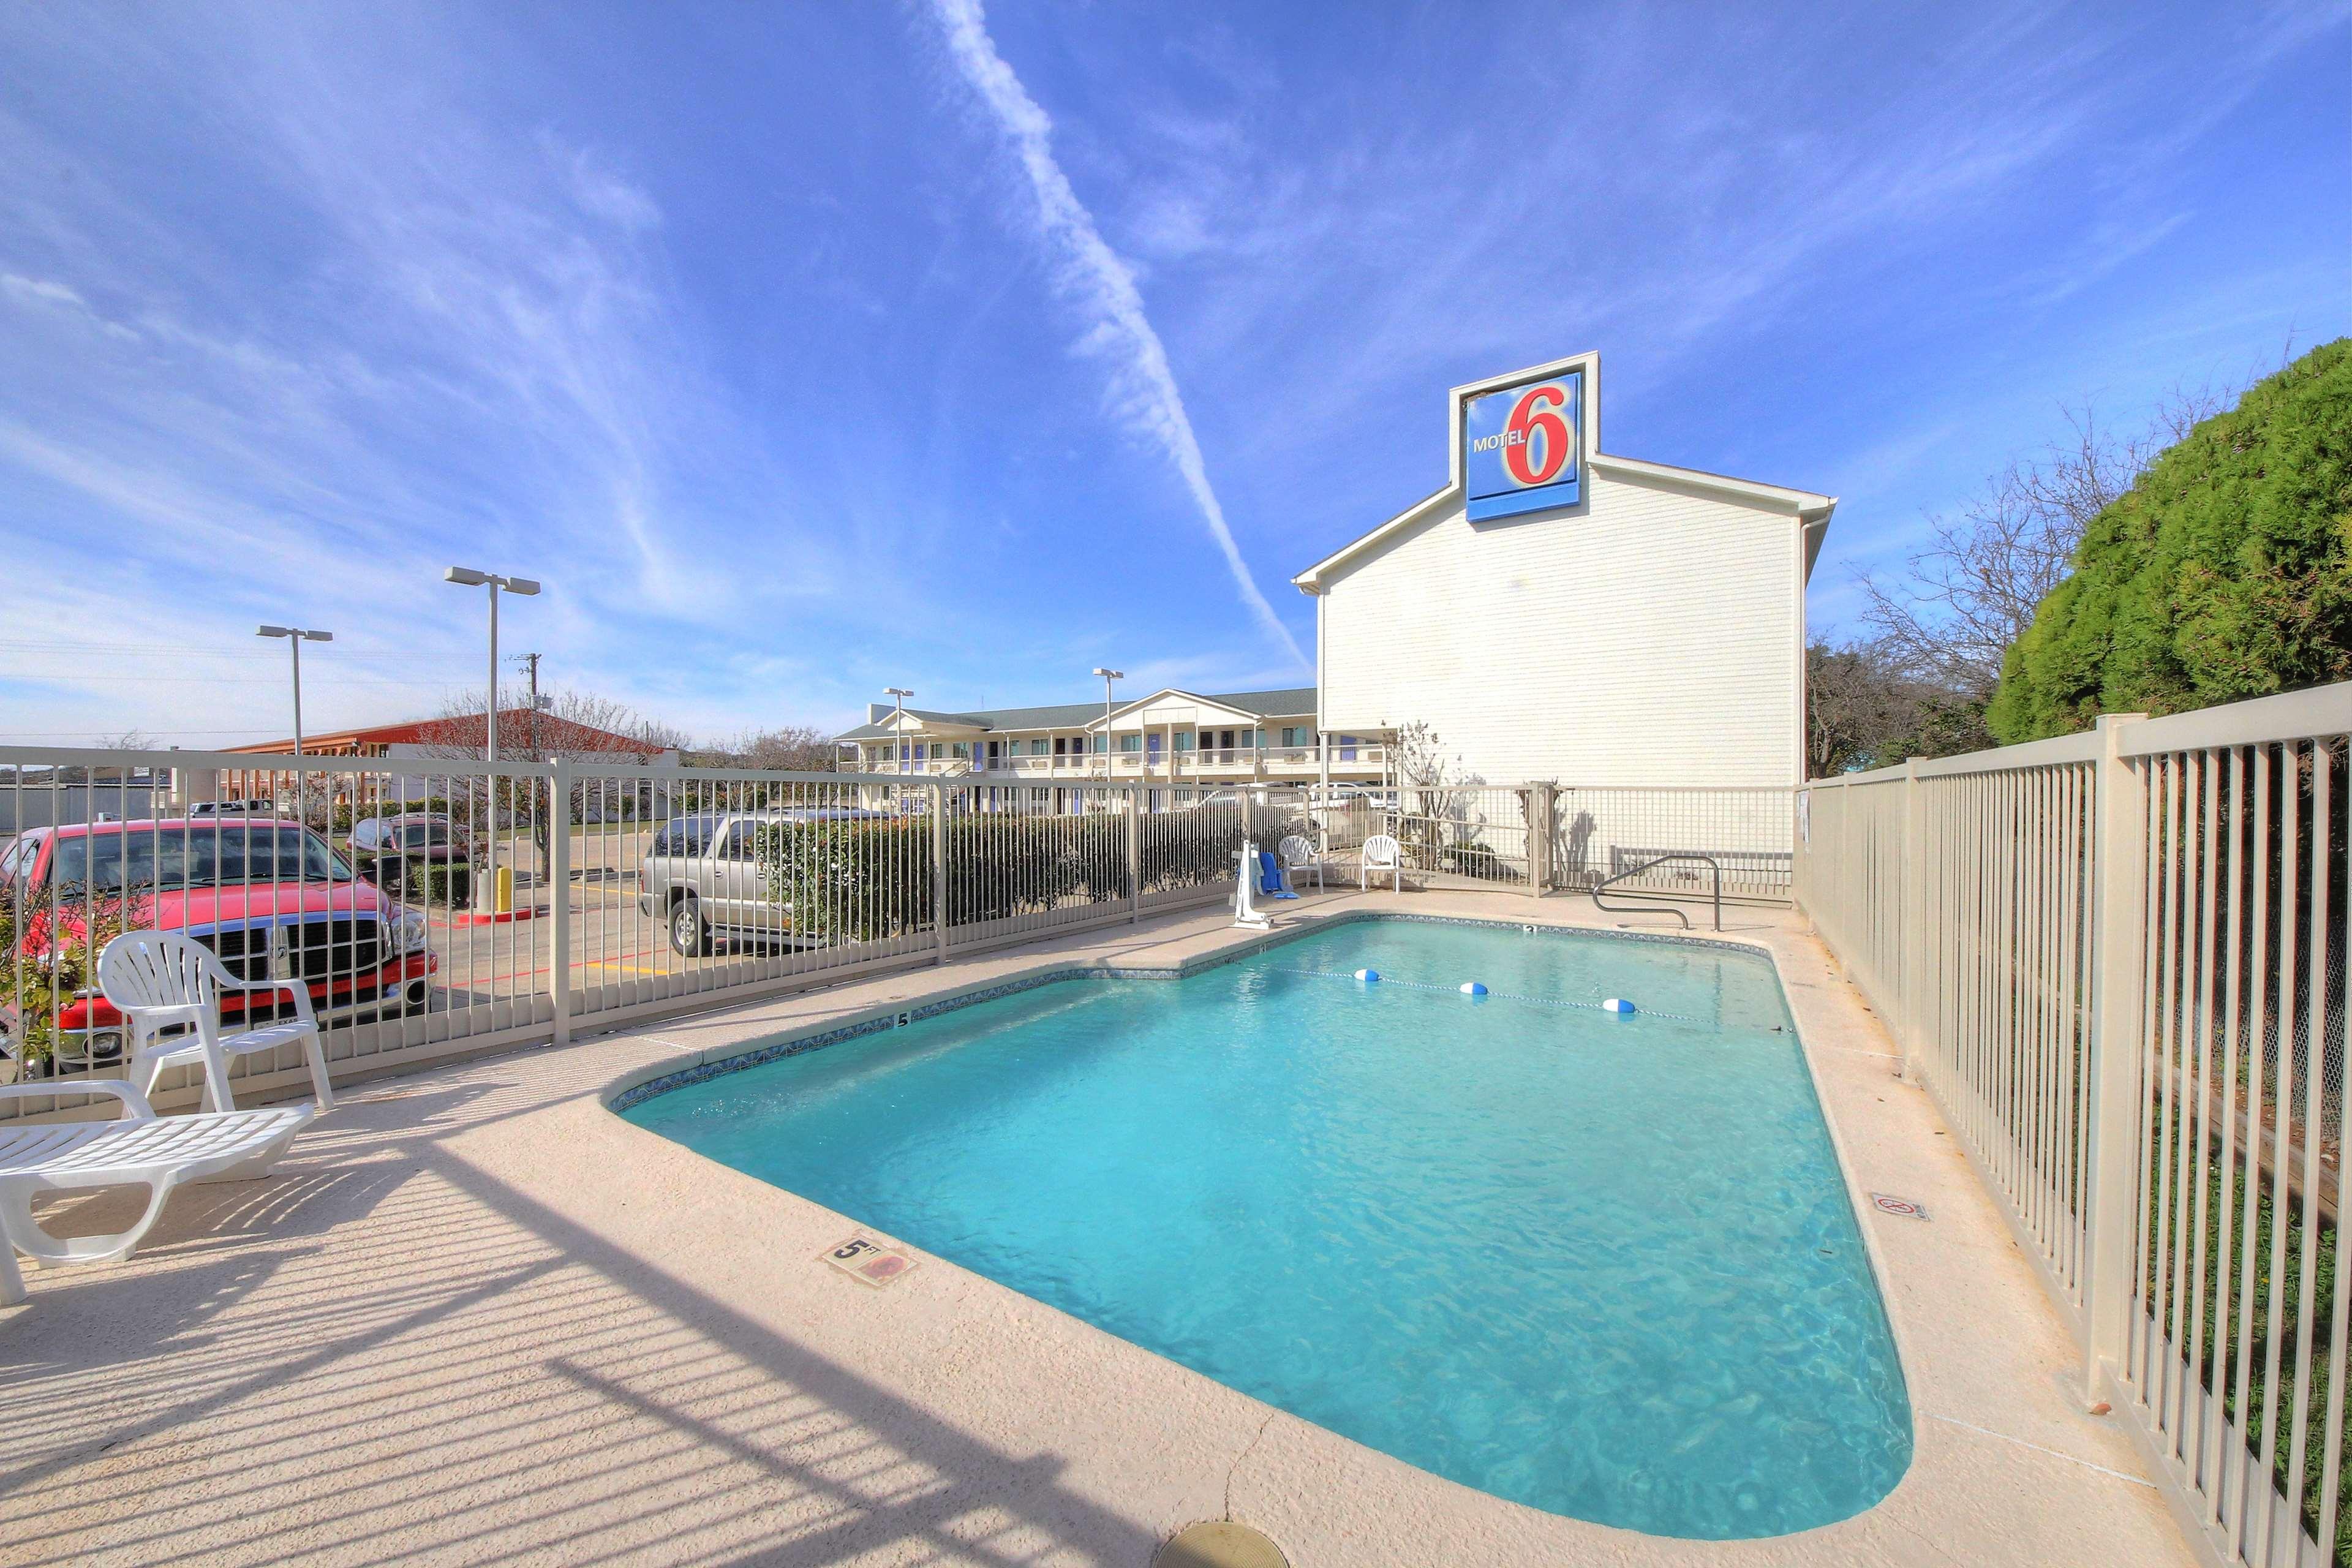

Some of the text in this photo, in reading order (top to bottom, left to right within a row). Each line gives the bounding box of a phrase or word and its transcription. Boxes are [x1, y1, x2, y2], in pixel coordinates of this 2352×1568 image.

[1474, 386, 1568, 484] MOTEL 6
[897, 1012, 908, 1027] 5
[834, 1240, 881, 1259] 5 FT
